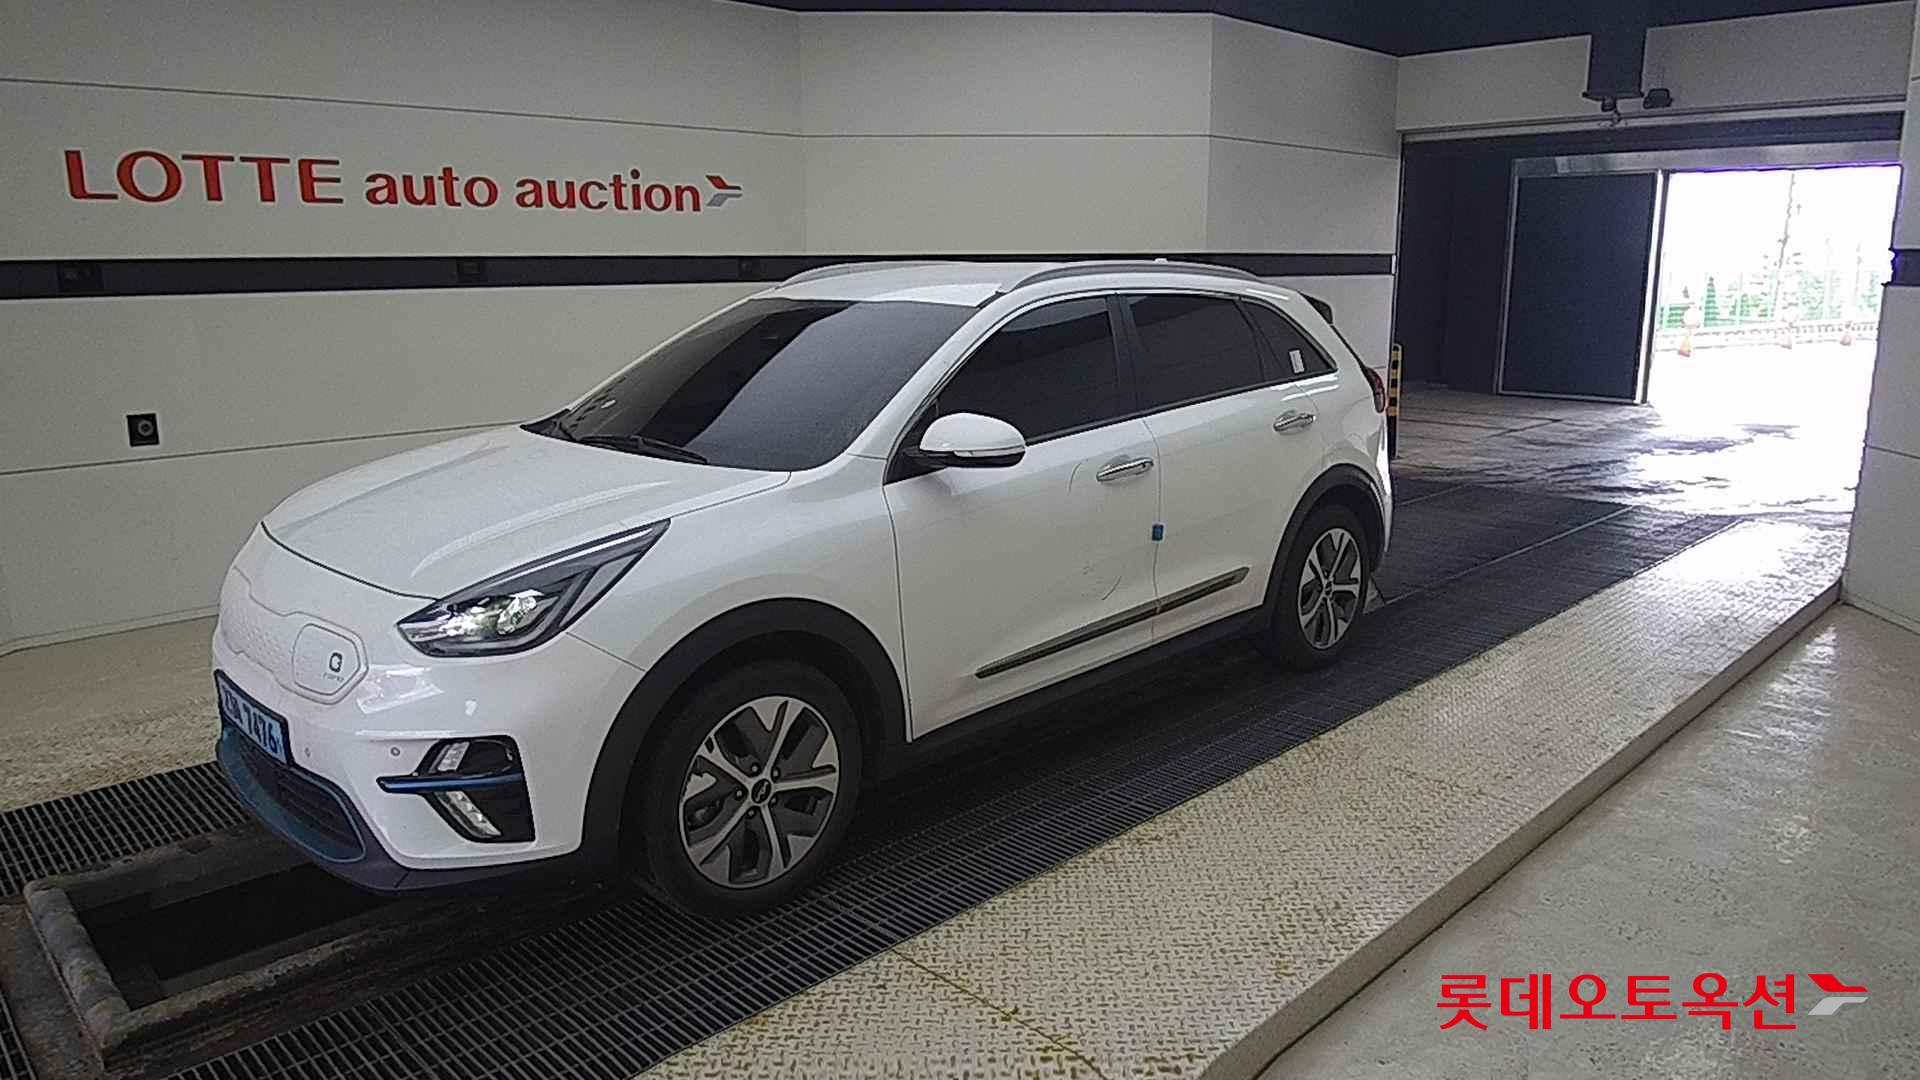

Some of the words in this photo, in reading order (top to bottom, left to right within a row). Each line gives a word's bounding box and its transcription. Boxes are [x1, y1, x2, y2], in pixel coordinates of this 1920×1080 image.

[64, 150, 343, 204] LOTTE
[365, 167, 498, 208] auto
[515, 169, 702, 212] auction
